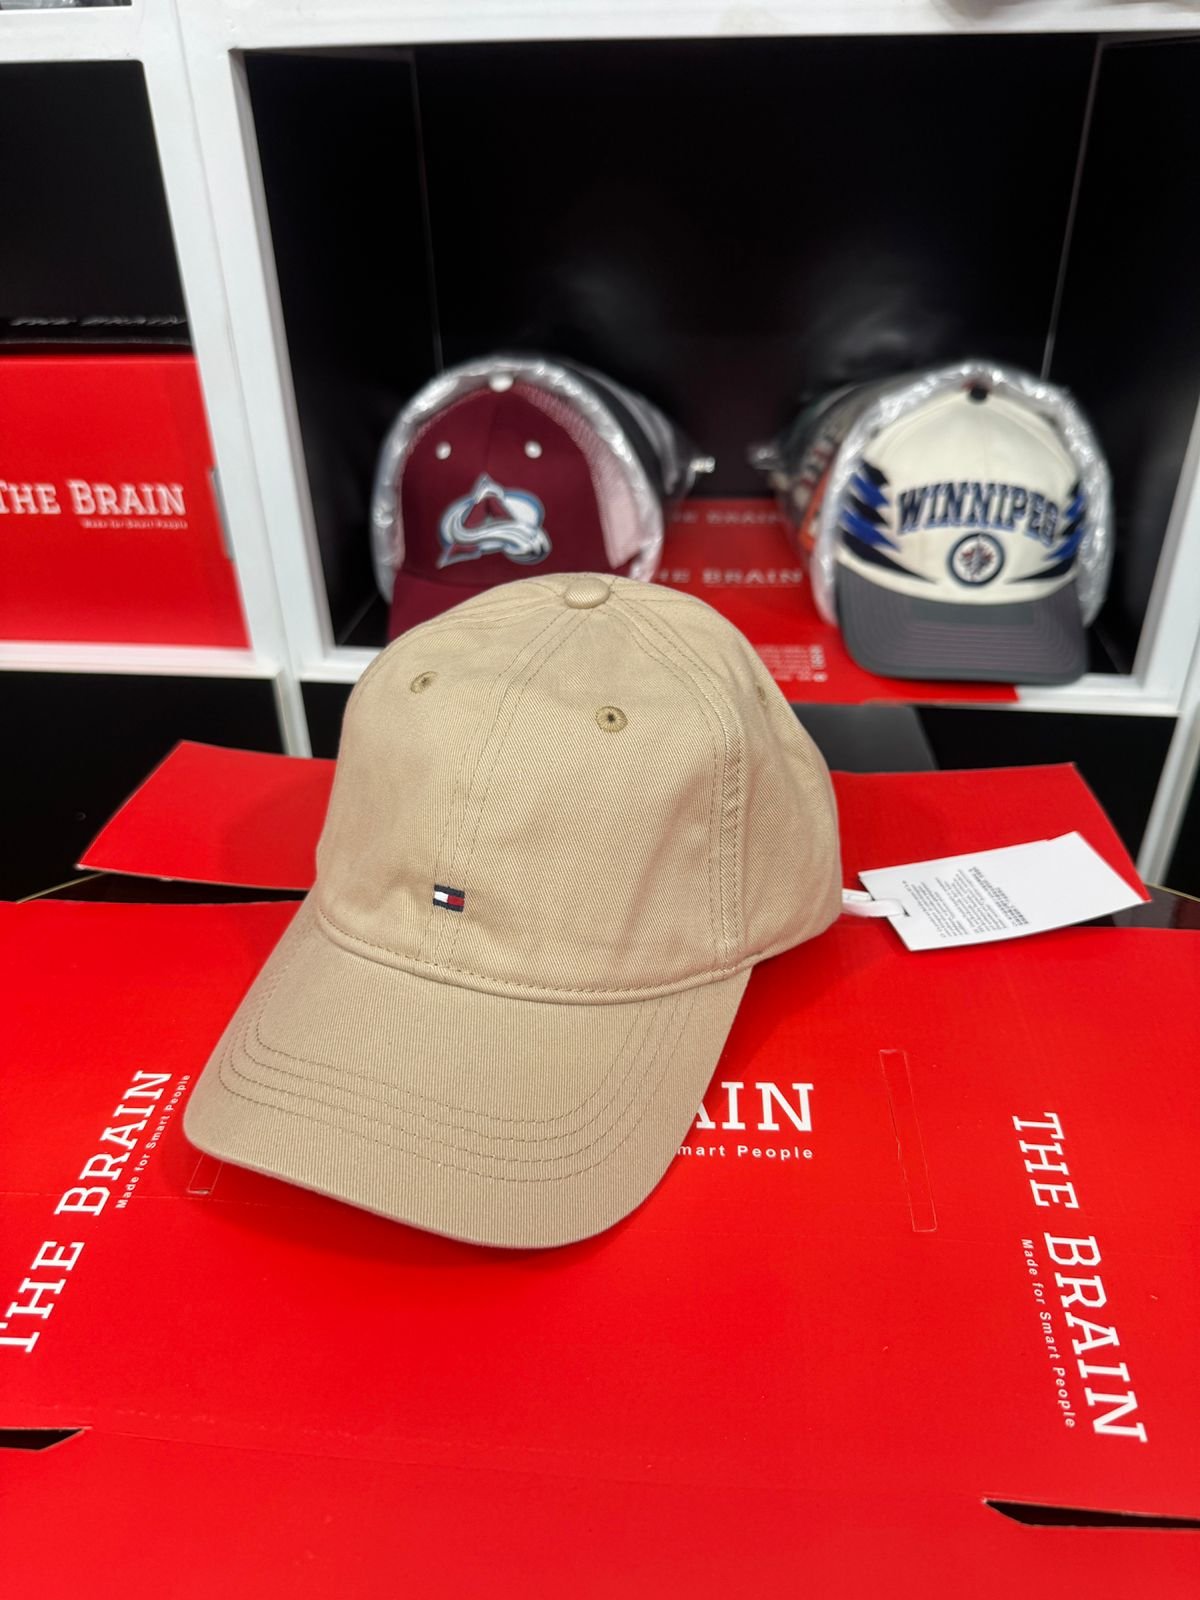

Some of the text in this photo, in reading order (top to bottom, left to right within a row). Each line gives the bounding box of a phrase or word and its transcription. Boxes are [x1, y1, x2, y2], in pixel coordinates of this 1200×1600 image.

[898, 481, 1059, 549] WINNIPEG
[54, 1070, 173, 1216] BRAIN
[115, 1176, 140, 1209] Made
[133, 1154, 151, 1171] for
[145, 1115, 171, 1149] Smart
[677, 1145, 814, 1161] mart People
[1012, 1111, 1148, 1443] THE BRAIN
[1021, 1238, 1077, 1428] Made for Smart People
